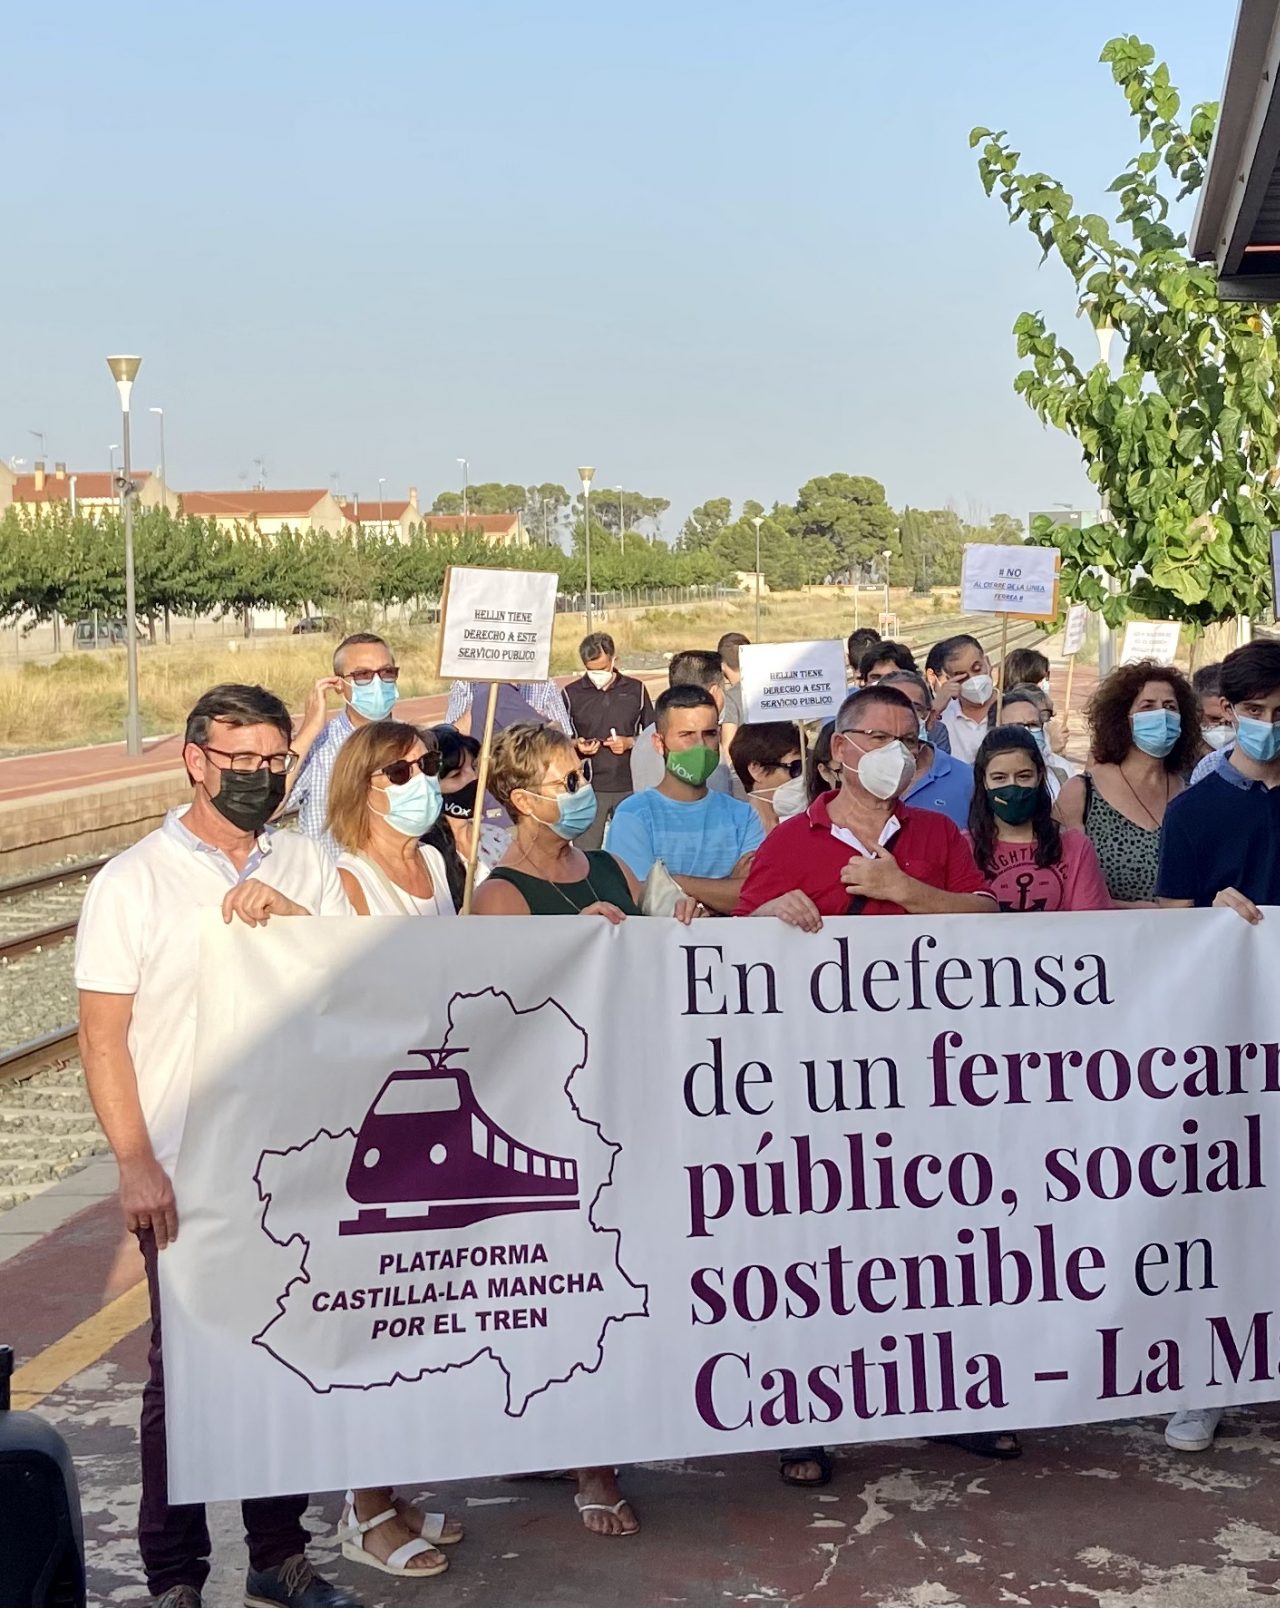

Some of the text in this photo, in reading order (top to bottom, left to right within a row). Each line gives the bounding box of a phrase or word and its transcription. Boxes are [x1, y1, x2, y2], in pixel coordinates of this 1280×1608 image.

[1006, 568, 1022, 578] NO
[474, 609, 533, 622] HELLIN TIENE
[463, 629, 537, 643] DERECHO A ESTE
[458, 647, 501, 660] SERVICIO
[770, 669, 823, 680] HELLIN TIENE
[763, 683, 831, 695] DERECHO A ESTE
[760, 698, 798, 709] SERVICIO
[671, 762, 694, 781] VOX
[444, 802, 471, 818] VOX
[989, 846, 1039, 871] UGHTY
[680, 934, 1115, 1017] En defensa
[683, 1037, 774, 1118] de
[800, 1056, 906, 1113] un
[684, 1131, 1018, 1238] público,
[1044, 1113, 1267, 1203] social
[379, 1243, 549, 1275] PLATAFORMA
[690, 1223, 1219, 1327] sostenible en
[311, 1272, 604, 1313] CASTILLA-LA MANCHA
[371, 1307, 548, 1340] POR EL TREN
[694, 1330, 1008, 1432] Castilla
[1095, 1327, 1185, 1400] La
